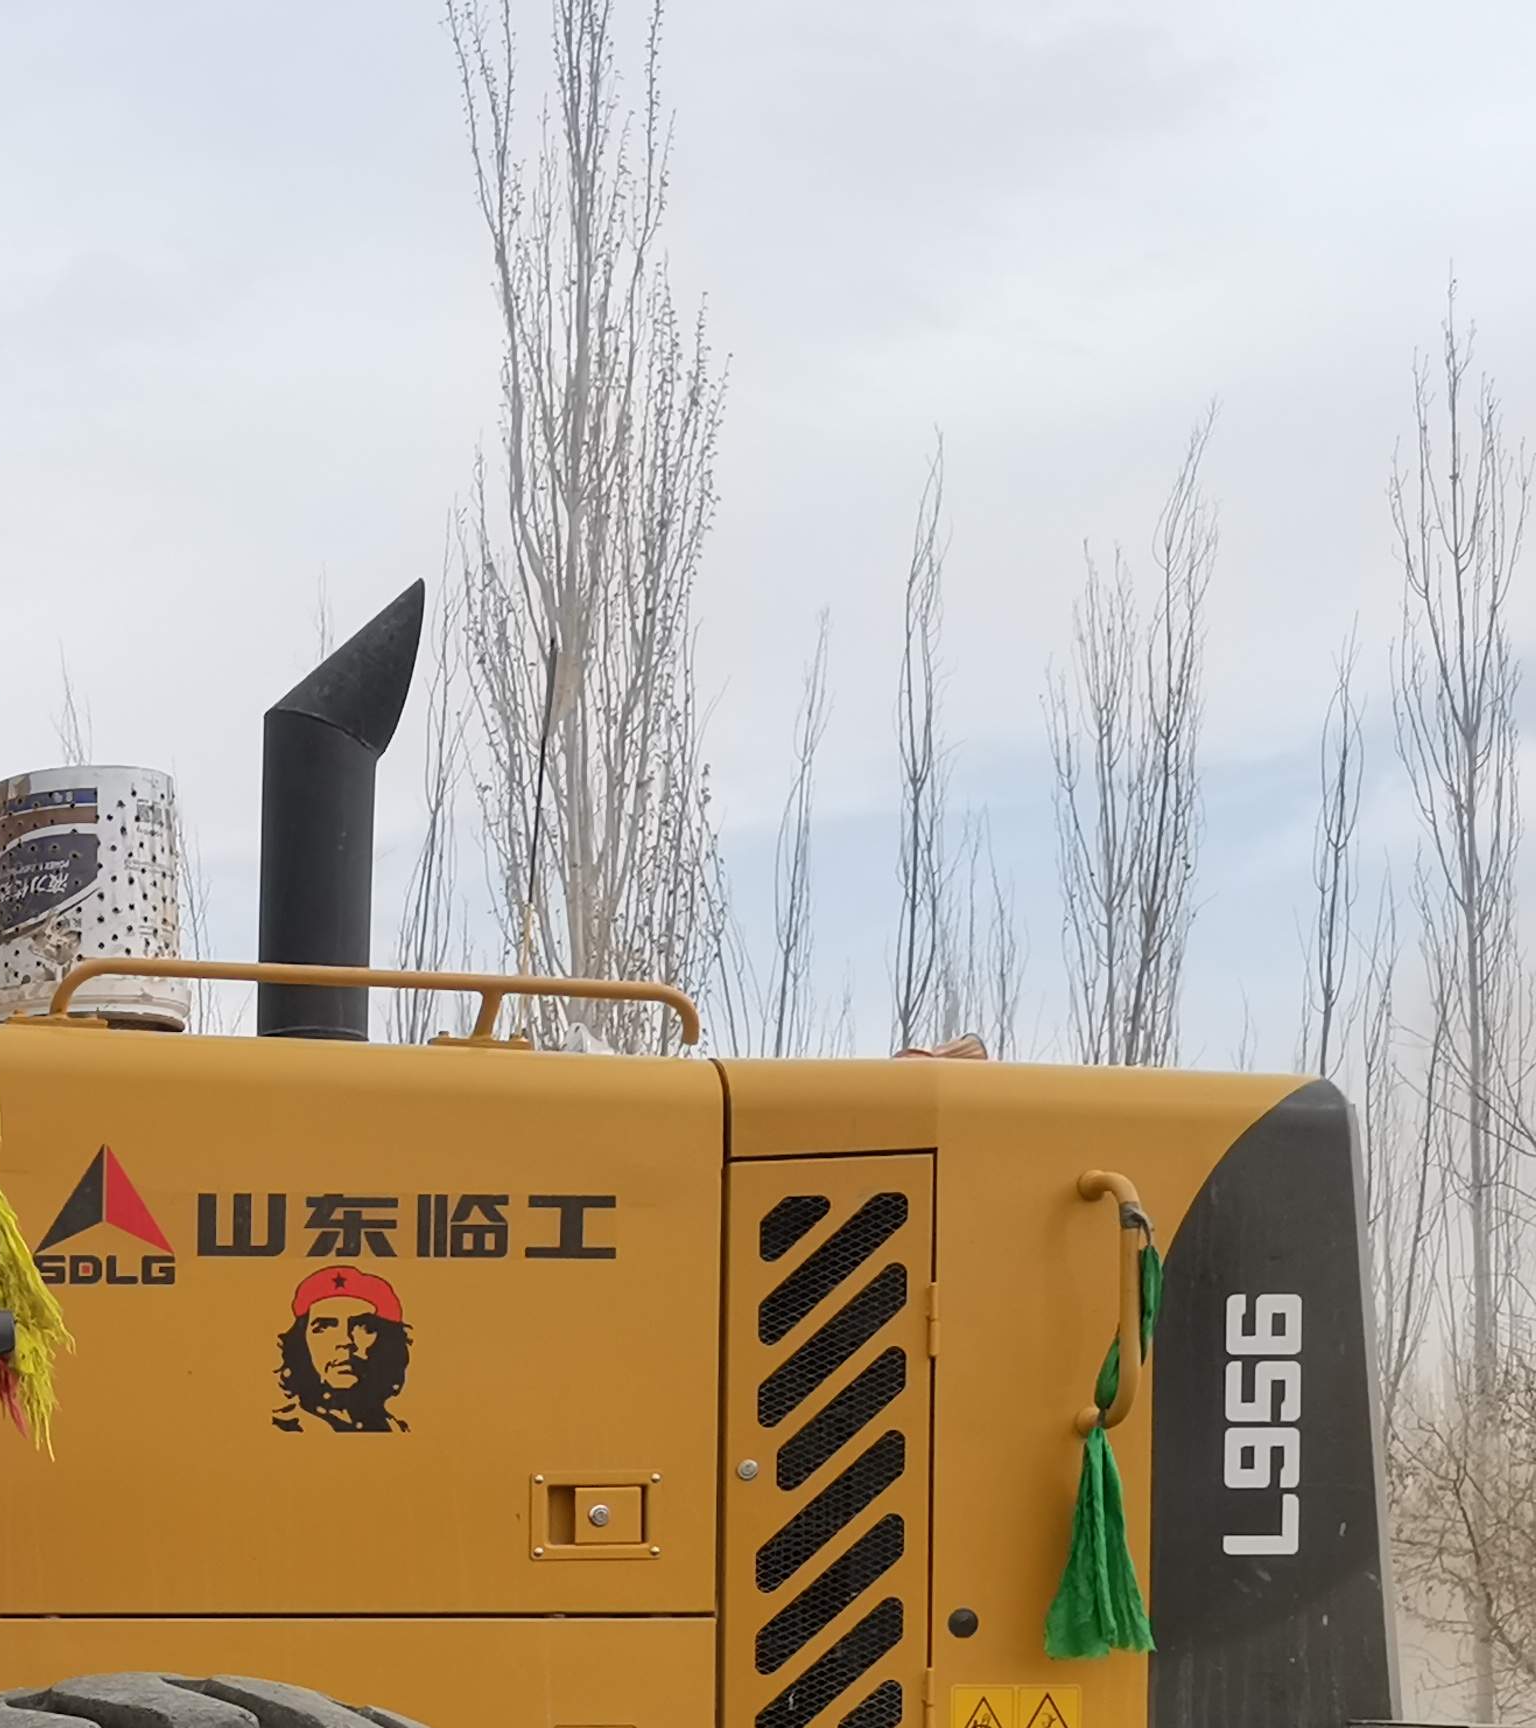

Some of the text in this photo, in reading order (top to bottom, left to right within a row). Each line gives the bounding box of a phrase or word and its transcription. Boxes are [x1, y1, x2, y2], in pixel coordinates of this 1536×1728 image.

[197, 1193, 617, 1259] 山东临工
[36, 1255, 175, 1286] SDLG
[1223, 1294, 1302, 1555] L956
